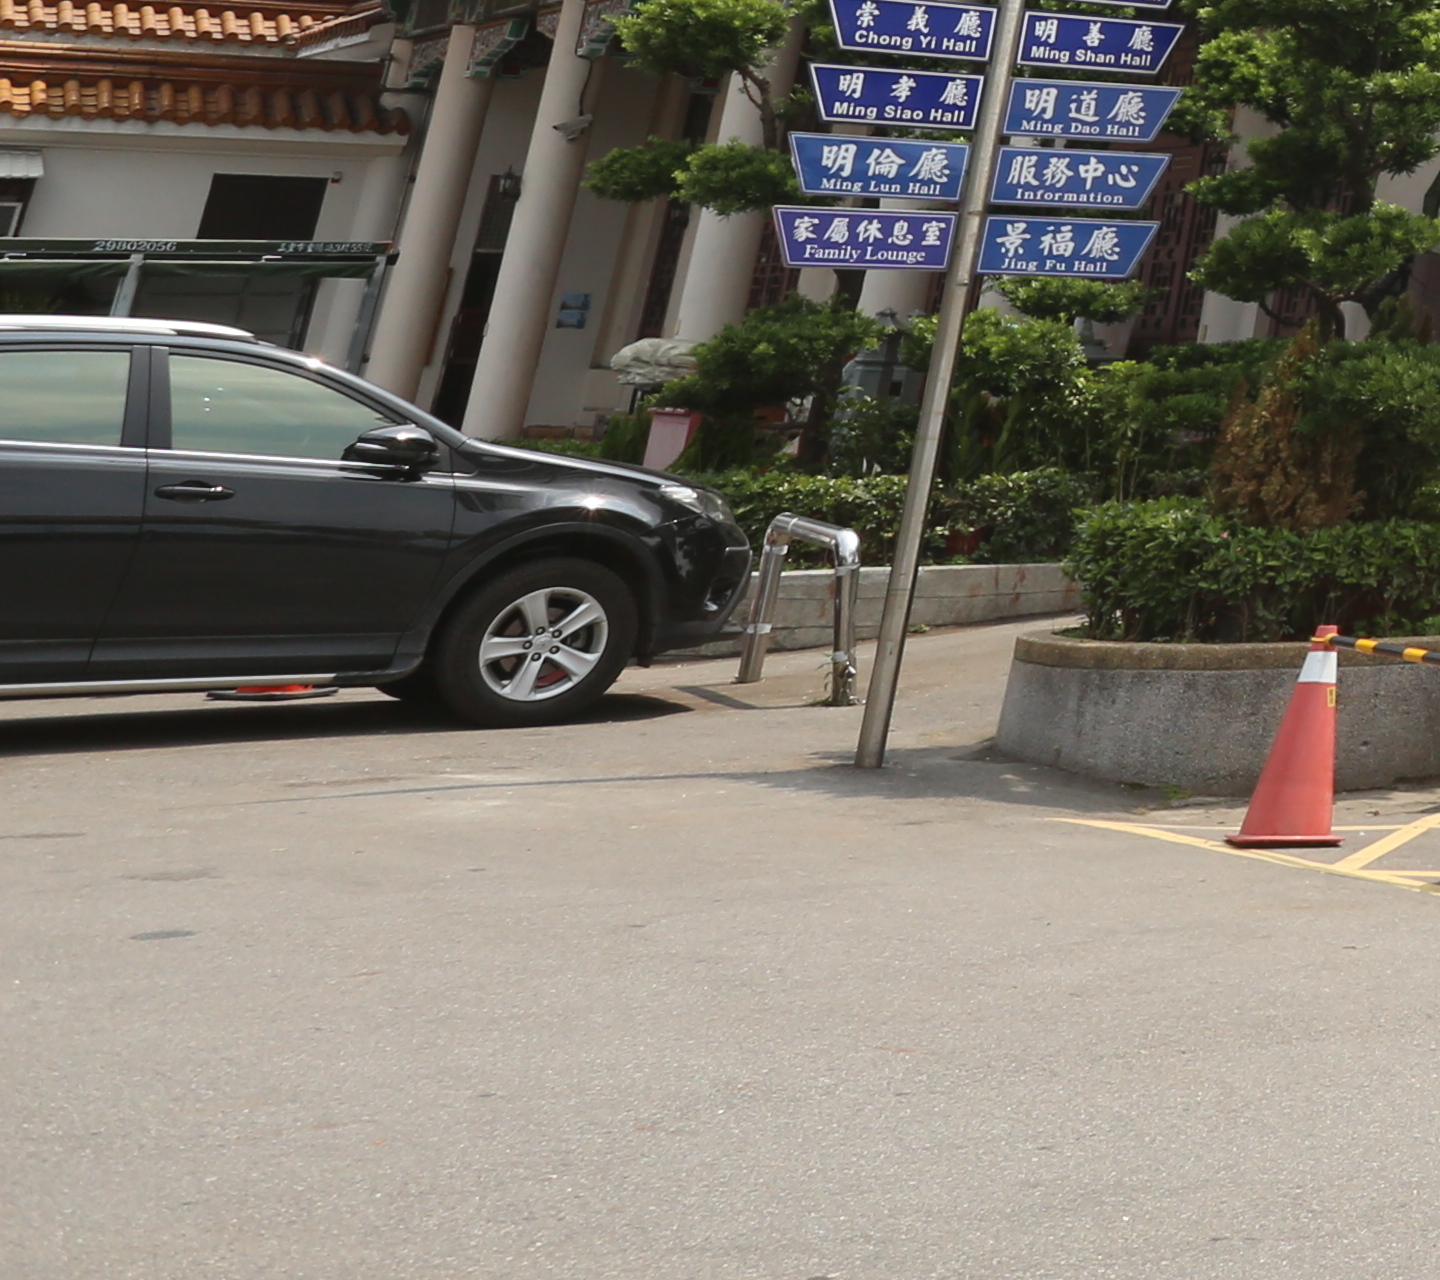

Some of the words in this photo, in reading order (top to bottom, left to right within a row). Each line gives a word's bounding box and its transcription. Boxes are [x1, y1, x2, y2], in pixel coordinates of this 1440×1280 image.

[856, 1, 982, 38] 崇義廳
[855, 30, 912, 49] Chong
[920, 36, 936, 48] Yi
[943, 38, 976, 52] Hall
[1035, 19, 1154, 52] 明善廳
[1031, 46, 1070, 62] Ming
[1075, 49, 1114, 63] Shan
[1121, 53, 1151, 66] Hall
[839, 73, 969, 106] 明孝廳
[833, 102, 877, 119] Ming
[884, 106, 923, 120] Siao
[930, 109, 964, 123] Hall
[1025, 87, 1147, 125] 明道廳
[1021, 120, 1064, 134] Ming
[1070, 122, 1099, 134] Dao
[1107, 125, 1139, 136] Hall
[821, 144, 950, 183] 明倫廳
[1007, 155, 1139, 190] 服務中心
[821, 178, 863, 191] Ming
[869, 181, 900, 193] Lun
[907, 183, 940, 194] Hall
[1016, 189, 1124, 203] Information
[793, 216, 947, 246] 家屬休息室
[996, 222, 1121, 261] 景福廳
[94, 241, 176, 251] 29802056
[804, 245, 861, 262] Family
[865, 246, 925, 262] Lounge
[1001, 258, 1038, 271] Jing
[1045, 260, 1065, 271] Fu
[1073, 261, 1107, 272] Hall
